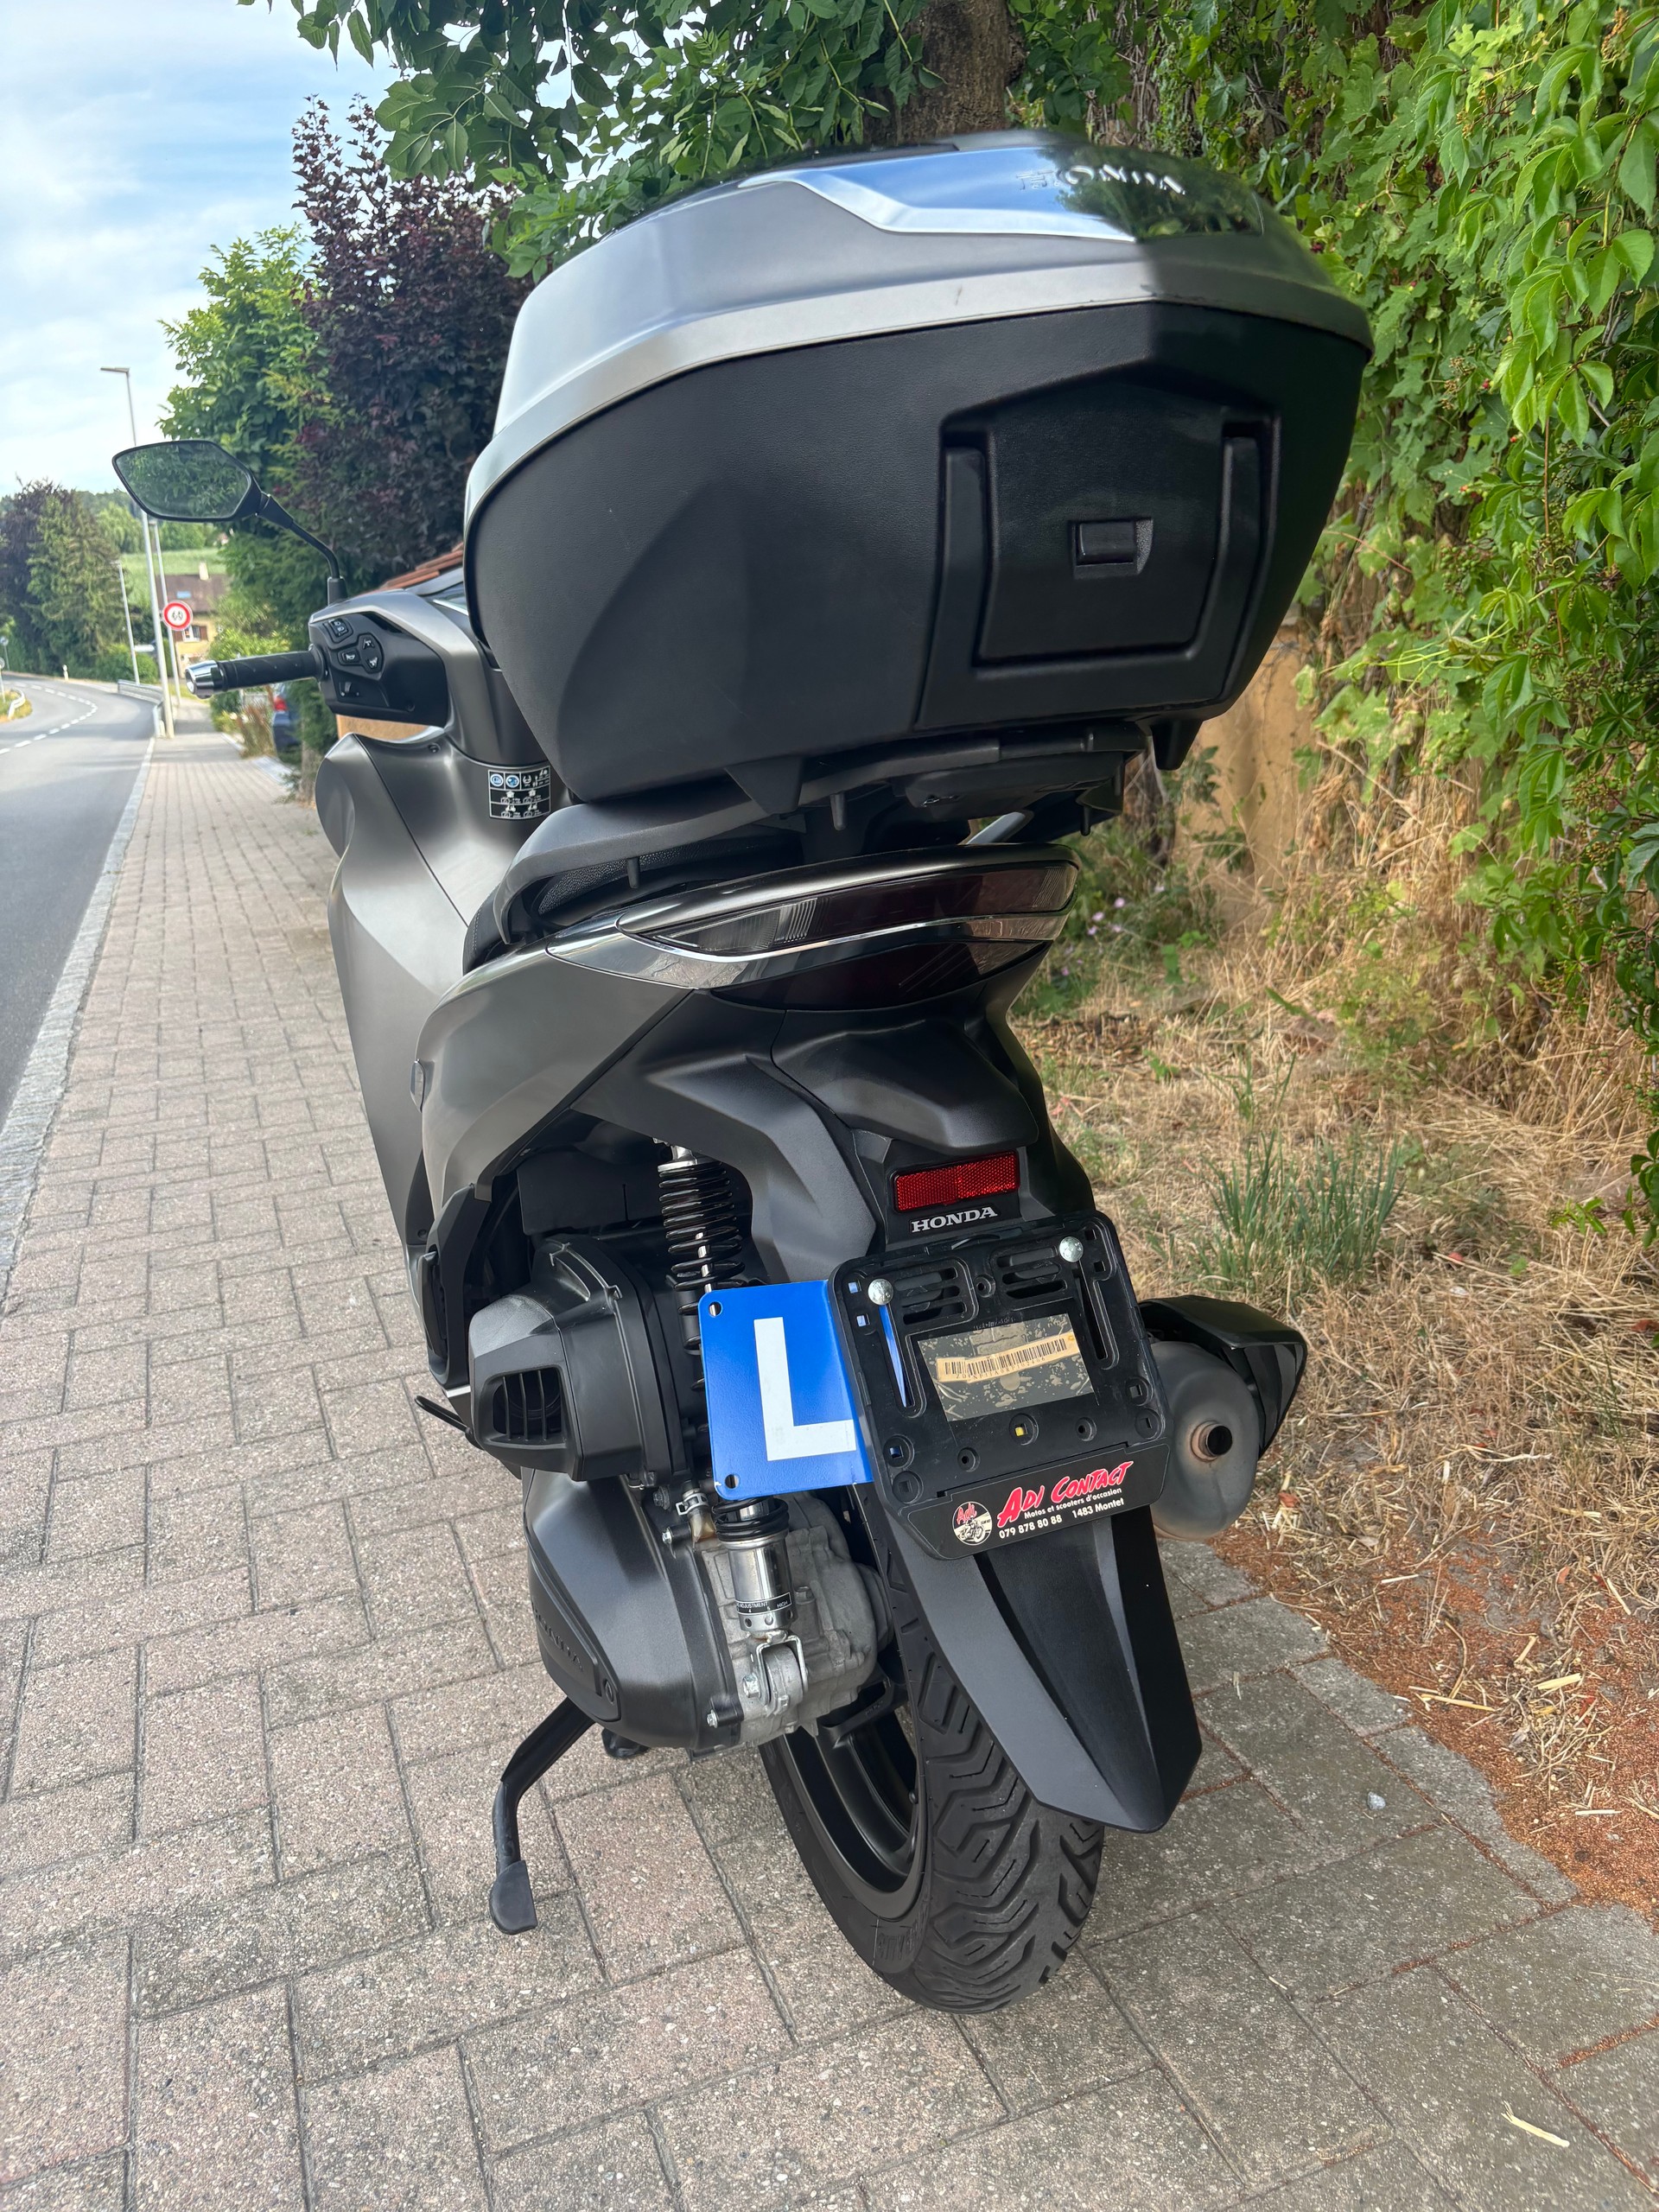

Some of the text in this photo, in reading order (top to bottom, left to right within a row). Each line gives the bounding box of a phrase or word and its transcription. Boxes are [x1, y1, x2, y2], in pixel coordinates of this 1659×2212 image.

[911, 1206, 998, 1233] HONDA
[753, 1316, 857, 1462] L
[996, 1460, 1135, 1529] ADI CONTACT
[1024, 1508, 1046, 1520] Motos
[1056, 1497, 1085, 1511] scooters
[999, 1497, 1125, 1540] 079 878 80 88 1483 Montet
